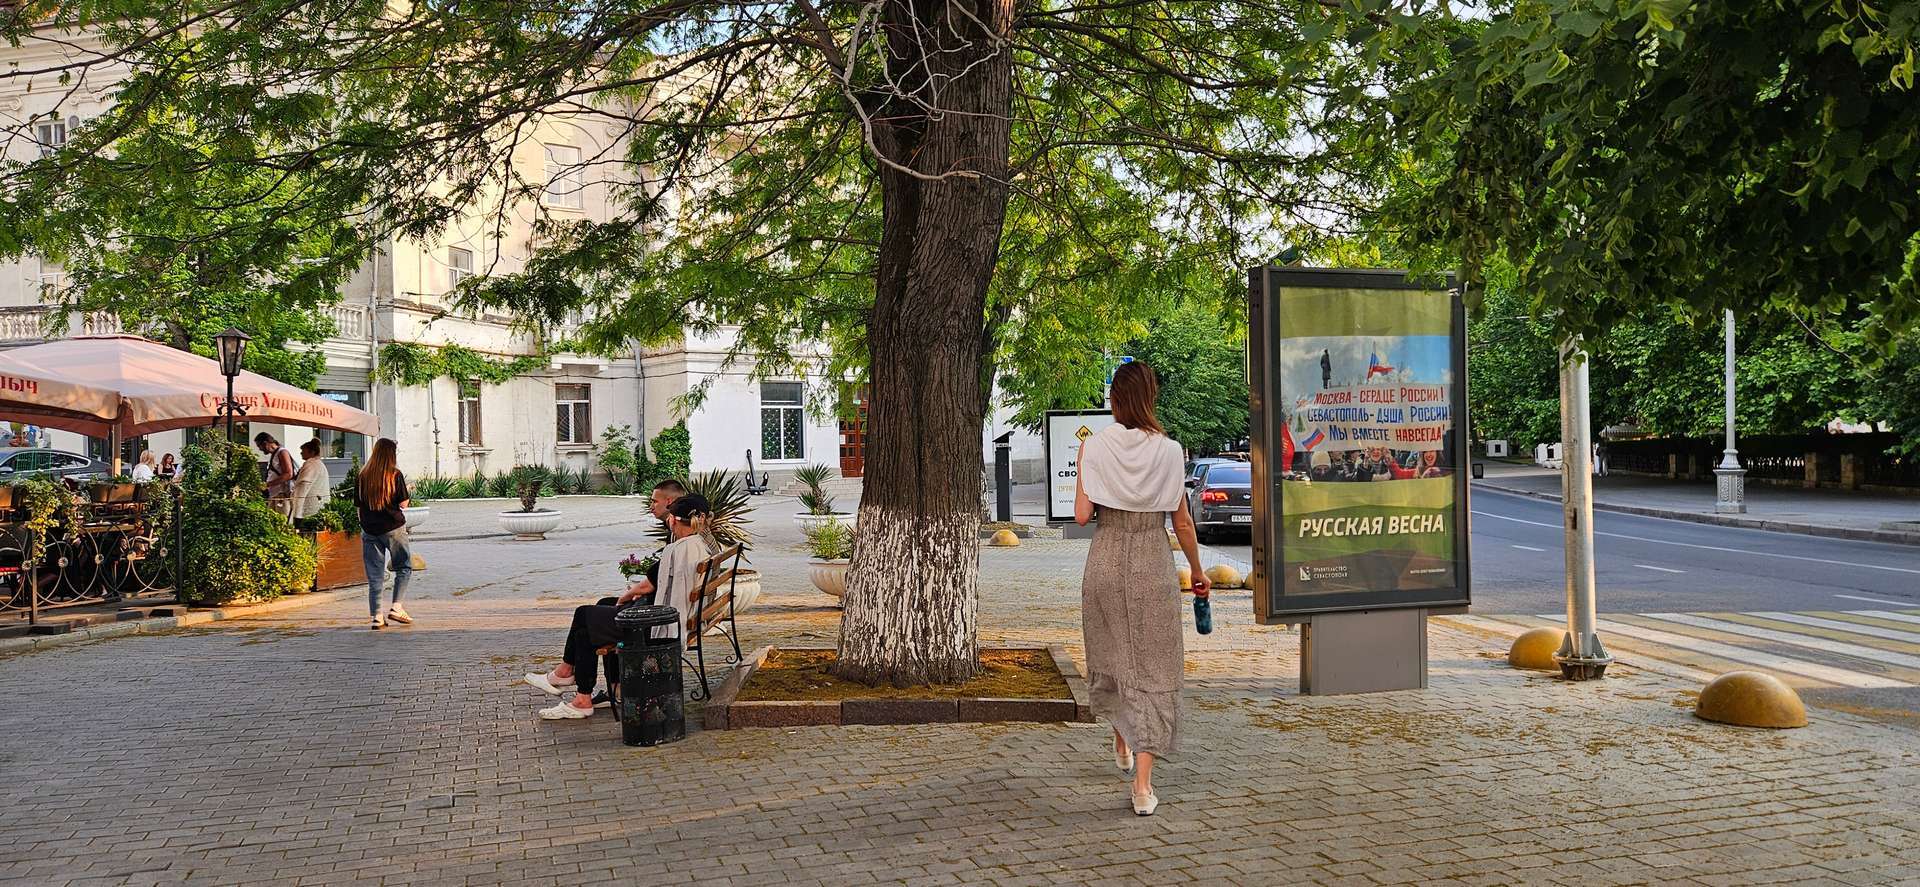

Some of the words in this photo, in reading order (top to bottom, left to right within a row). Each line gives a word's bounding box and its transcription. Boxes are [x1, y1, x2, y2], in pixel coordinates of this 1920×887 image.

[1359, 388, 1396, 404] СЕРДЦЕ
[200, 392, 258, 409] Стрик
[260, 392, 334, 418] Хинкалыч
[1376, 407, 1404, 424] ДУША
[1352, 427, 1390, 441] ВМЕСТЕ
[1299, 516, 1384, 538] РУССКАЯ
[1388, 514, 1444, 534] ВЕСНА
